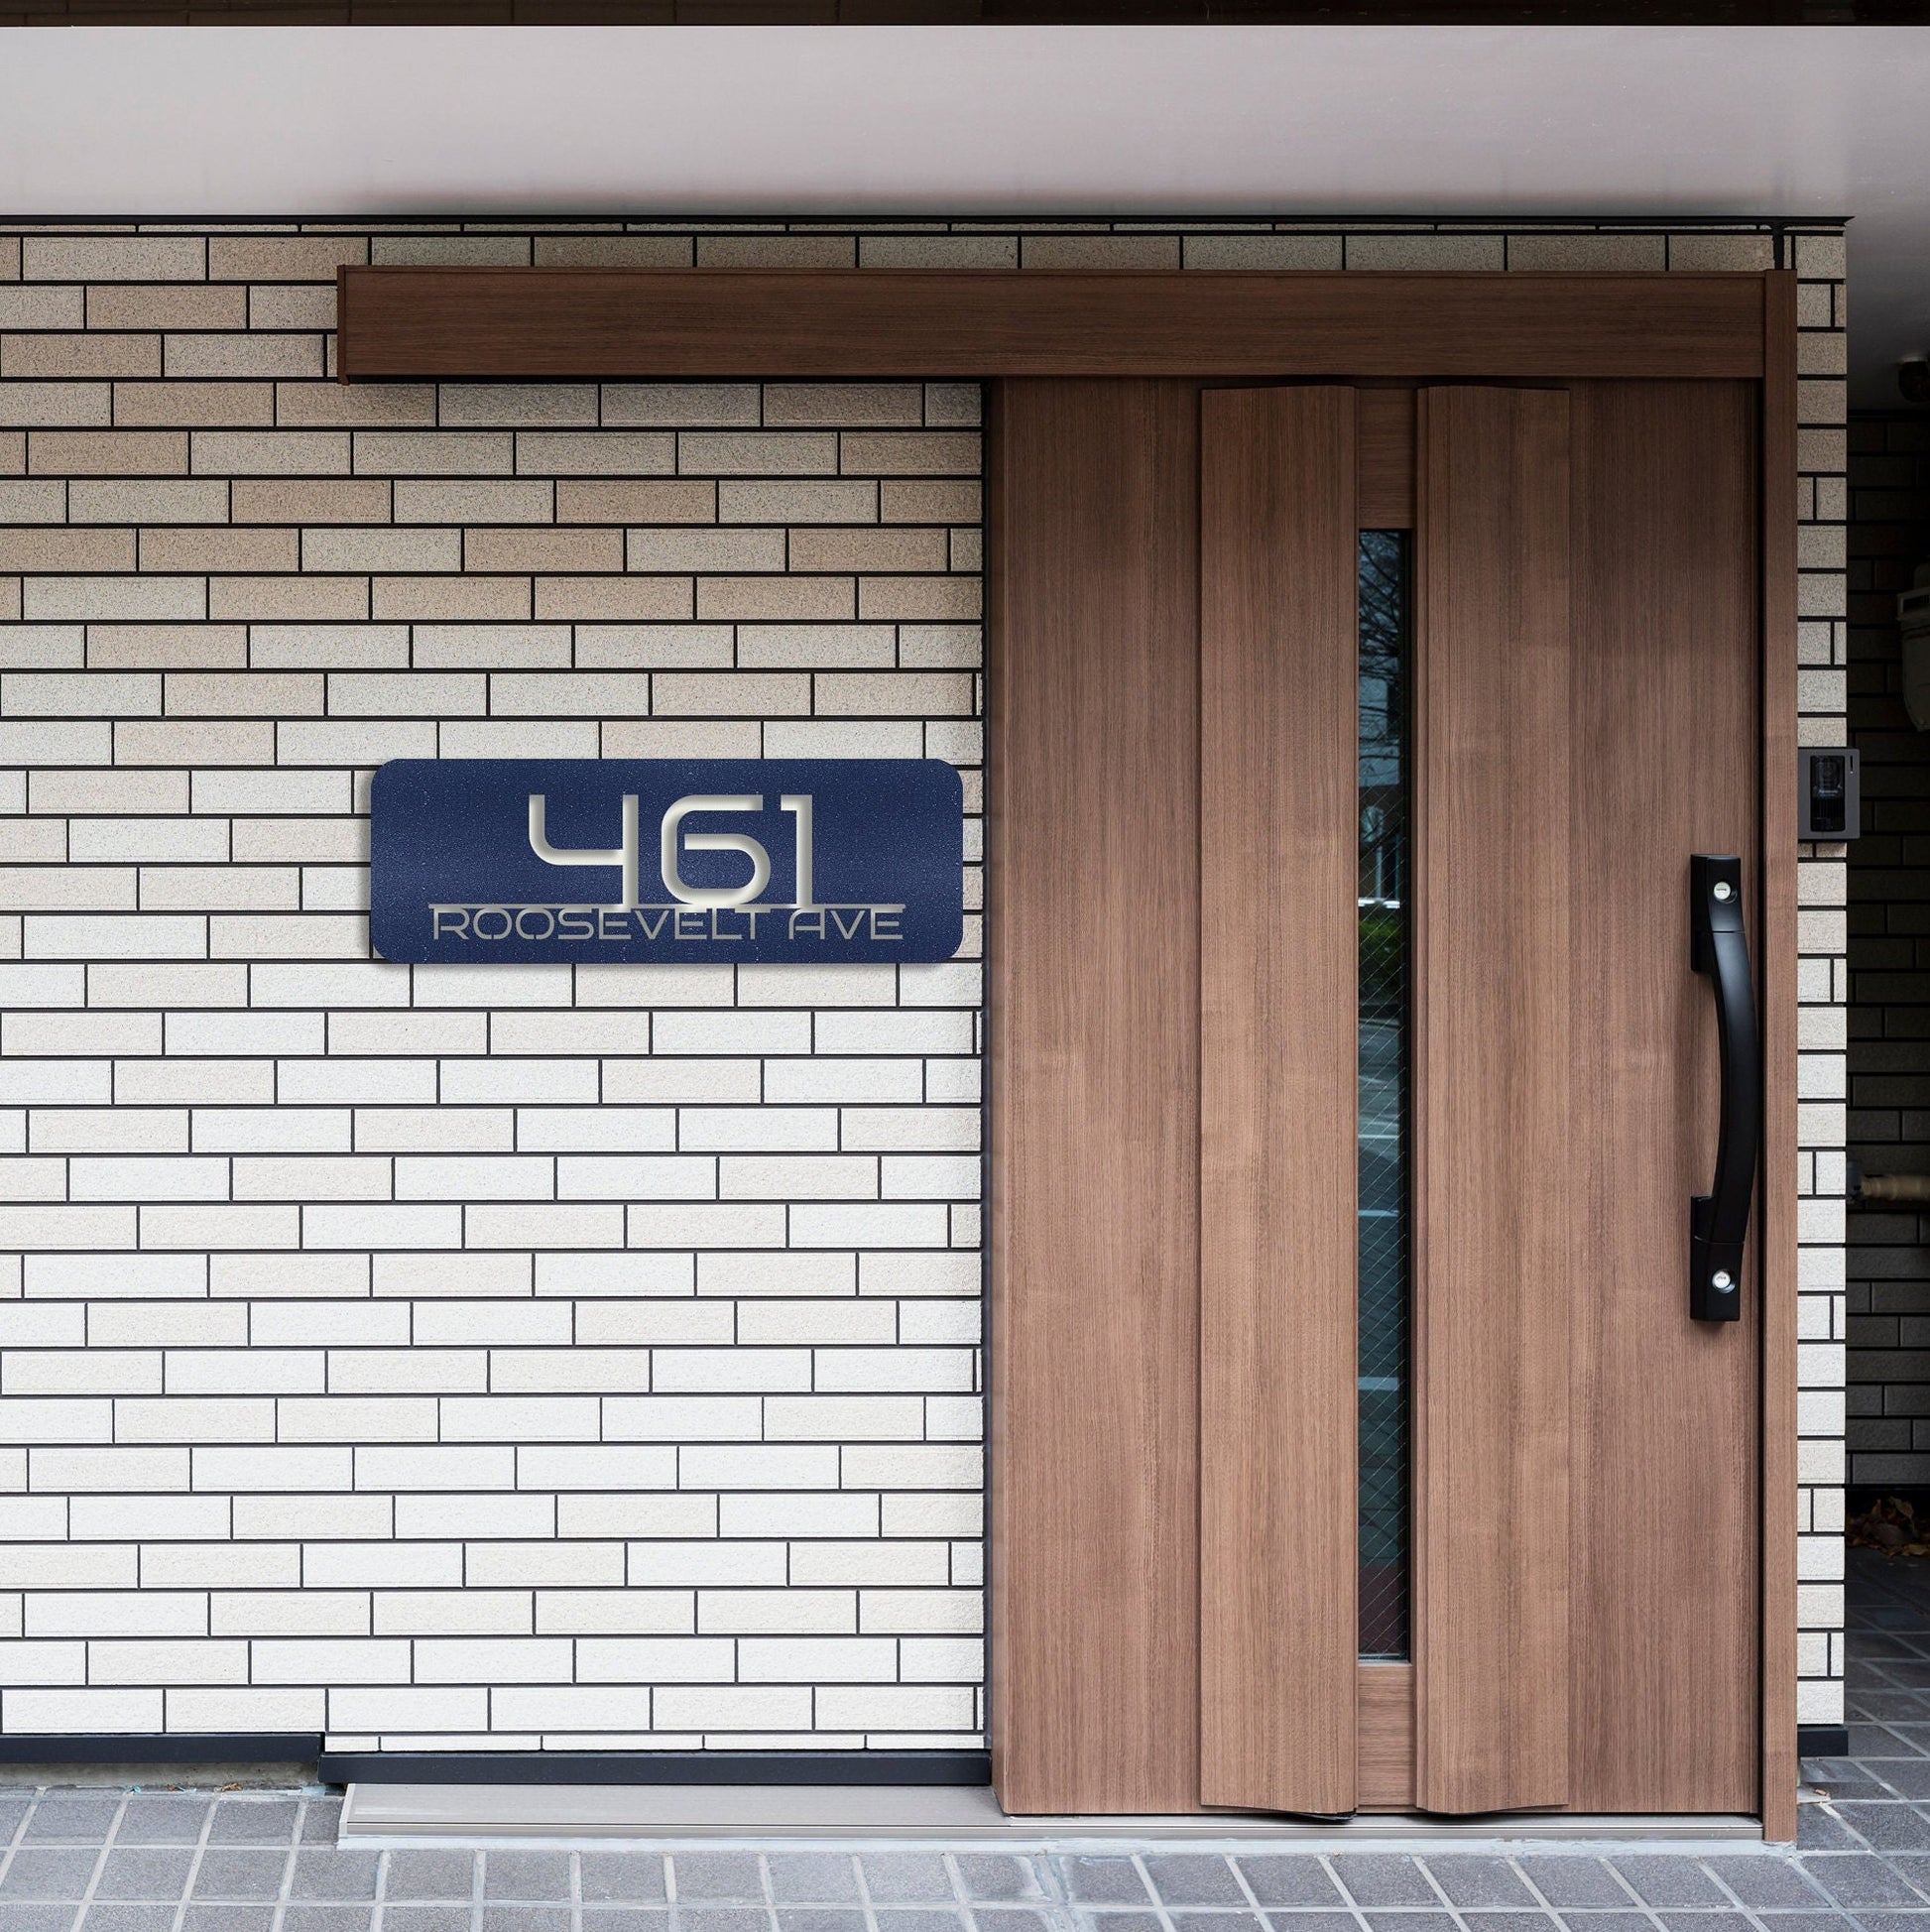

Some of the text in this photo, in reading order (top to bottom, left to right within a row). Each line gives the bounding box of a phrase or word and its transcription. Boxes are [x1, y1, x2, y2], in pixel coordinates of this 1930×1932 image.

[529, 794, 812, 909] 461
[432, 906, 904, 940] ROOSEVELT AVE
